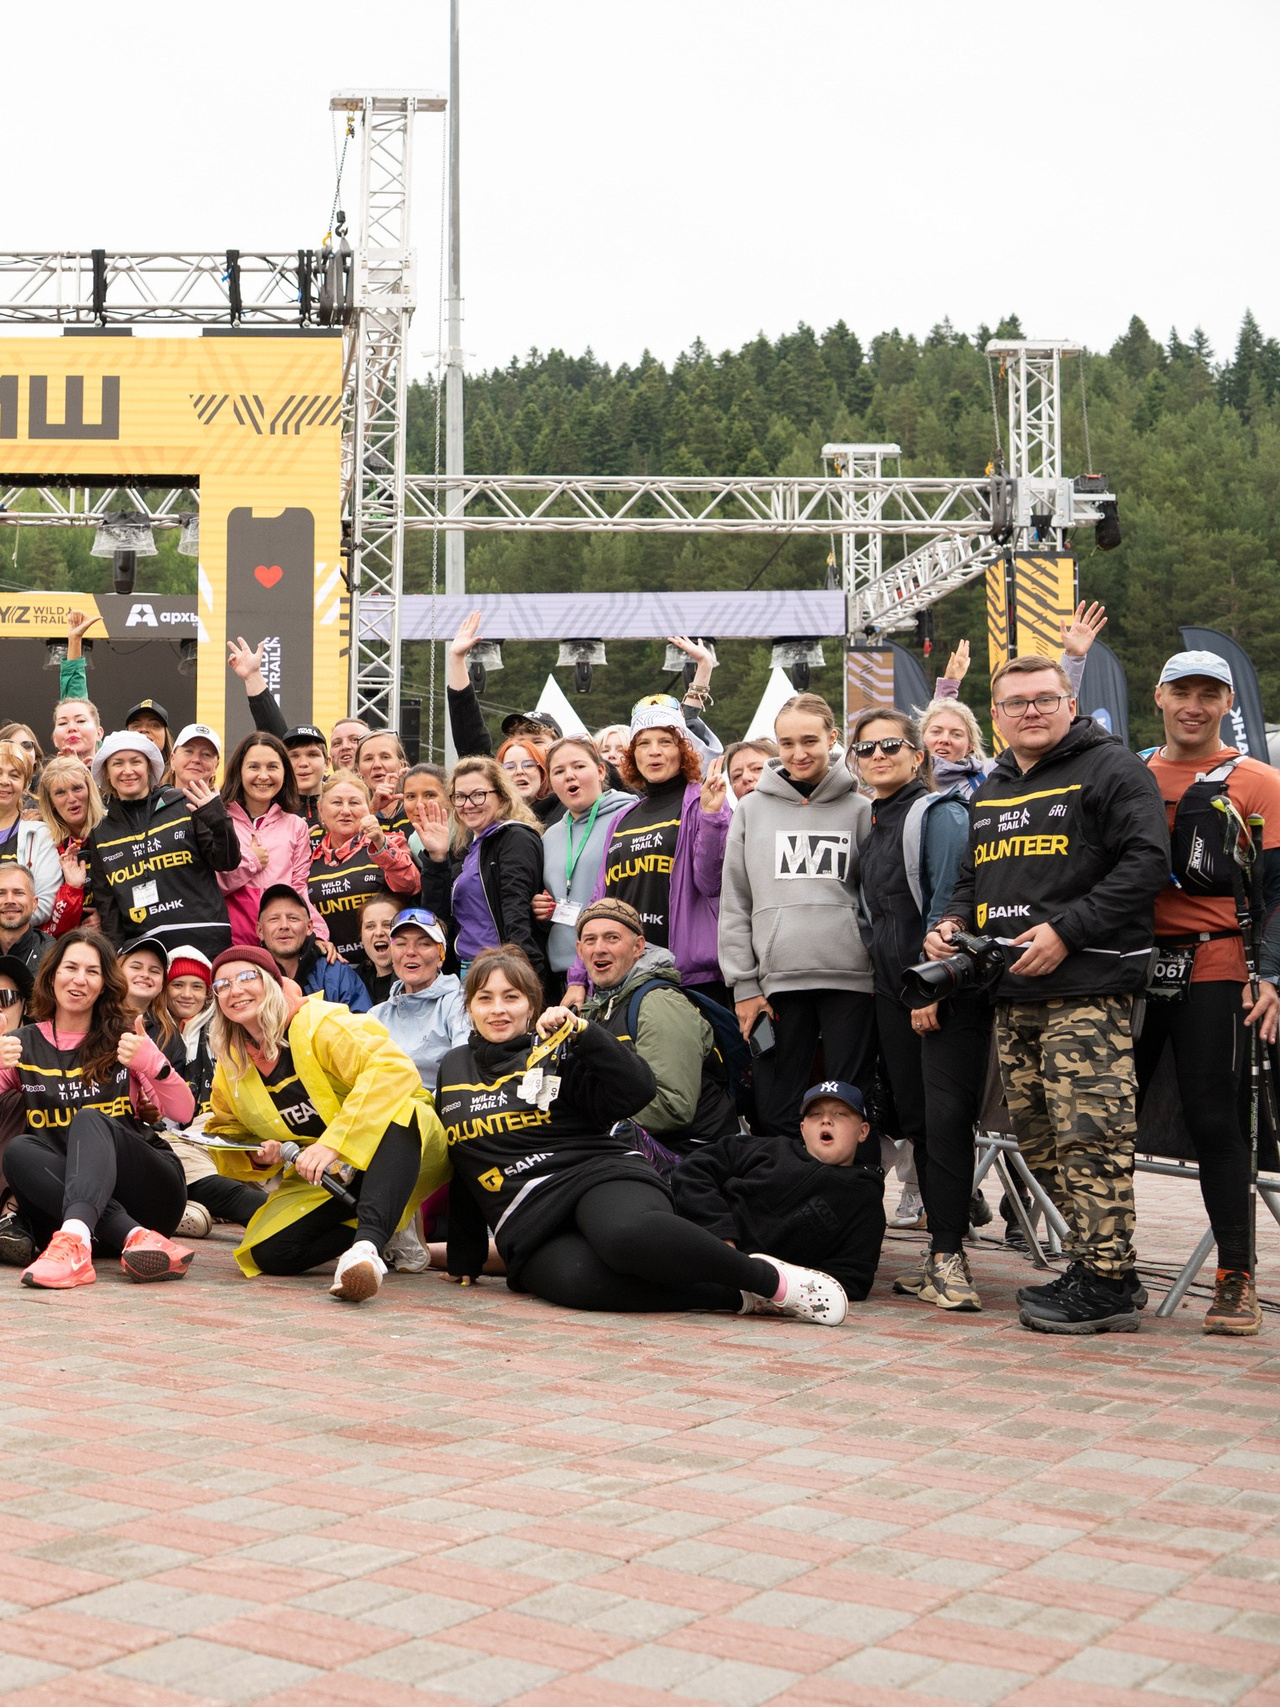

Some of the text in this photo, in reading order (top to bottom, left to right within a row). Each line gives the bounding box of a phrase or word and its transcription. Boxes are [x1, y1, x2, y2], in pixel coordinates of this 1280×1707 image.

[33, 606, 65, 615] WILD
[33, 615, 67, 625] TRAIL
[258, 650, 270, 688] ILD
[269, 643, 282, 692] TRAIL
[1000, 811, 1020, 822] WILD
[1048, 804, 1067, 817] GRi
[998, 820, 1020, 833] TRAIL
[632, 833, 652, 844] WILD
[630, 840, 653, 853] TRAIL
[106, 850, 193, 887] VOLUNTEER
[321, 880, 342, 890] WILD
[364, 874, 377, 883] GRi
[321, 886, 345, 896] TRAIL
[149, 898, 184, 915] БАНК
[314, 892, 380, 916] LUNTEE
[988, 904, 1031, 919] БАНК
[337, 941, 365, 953] БАН
[820, 1080, 839, 1093] NY
[471, 1093, 497, 1105] WILD
[279, 1098, 319, 1127] TEA
[470, 1101, 498, 1113] TRAIL
[445, 1110, 552, 1147] OLUNTEER
